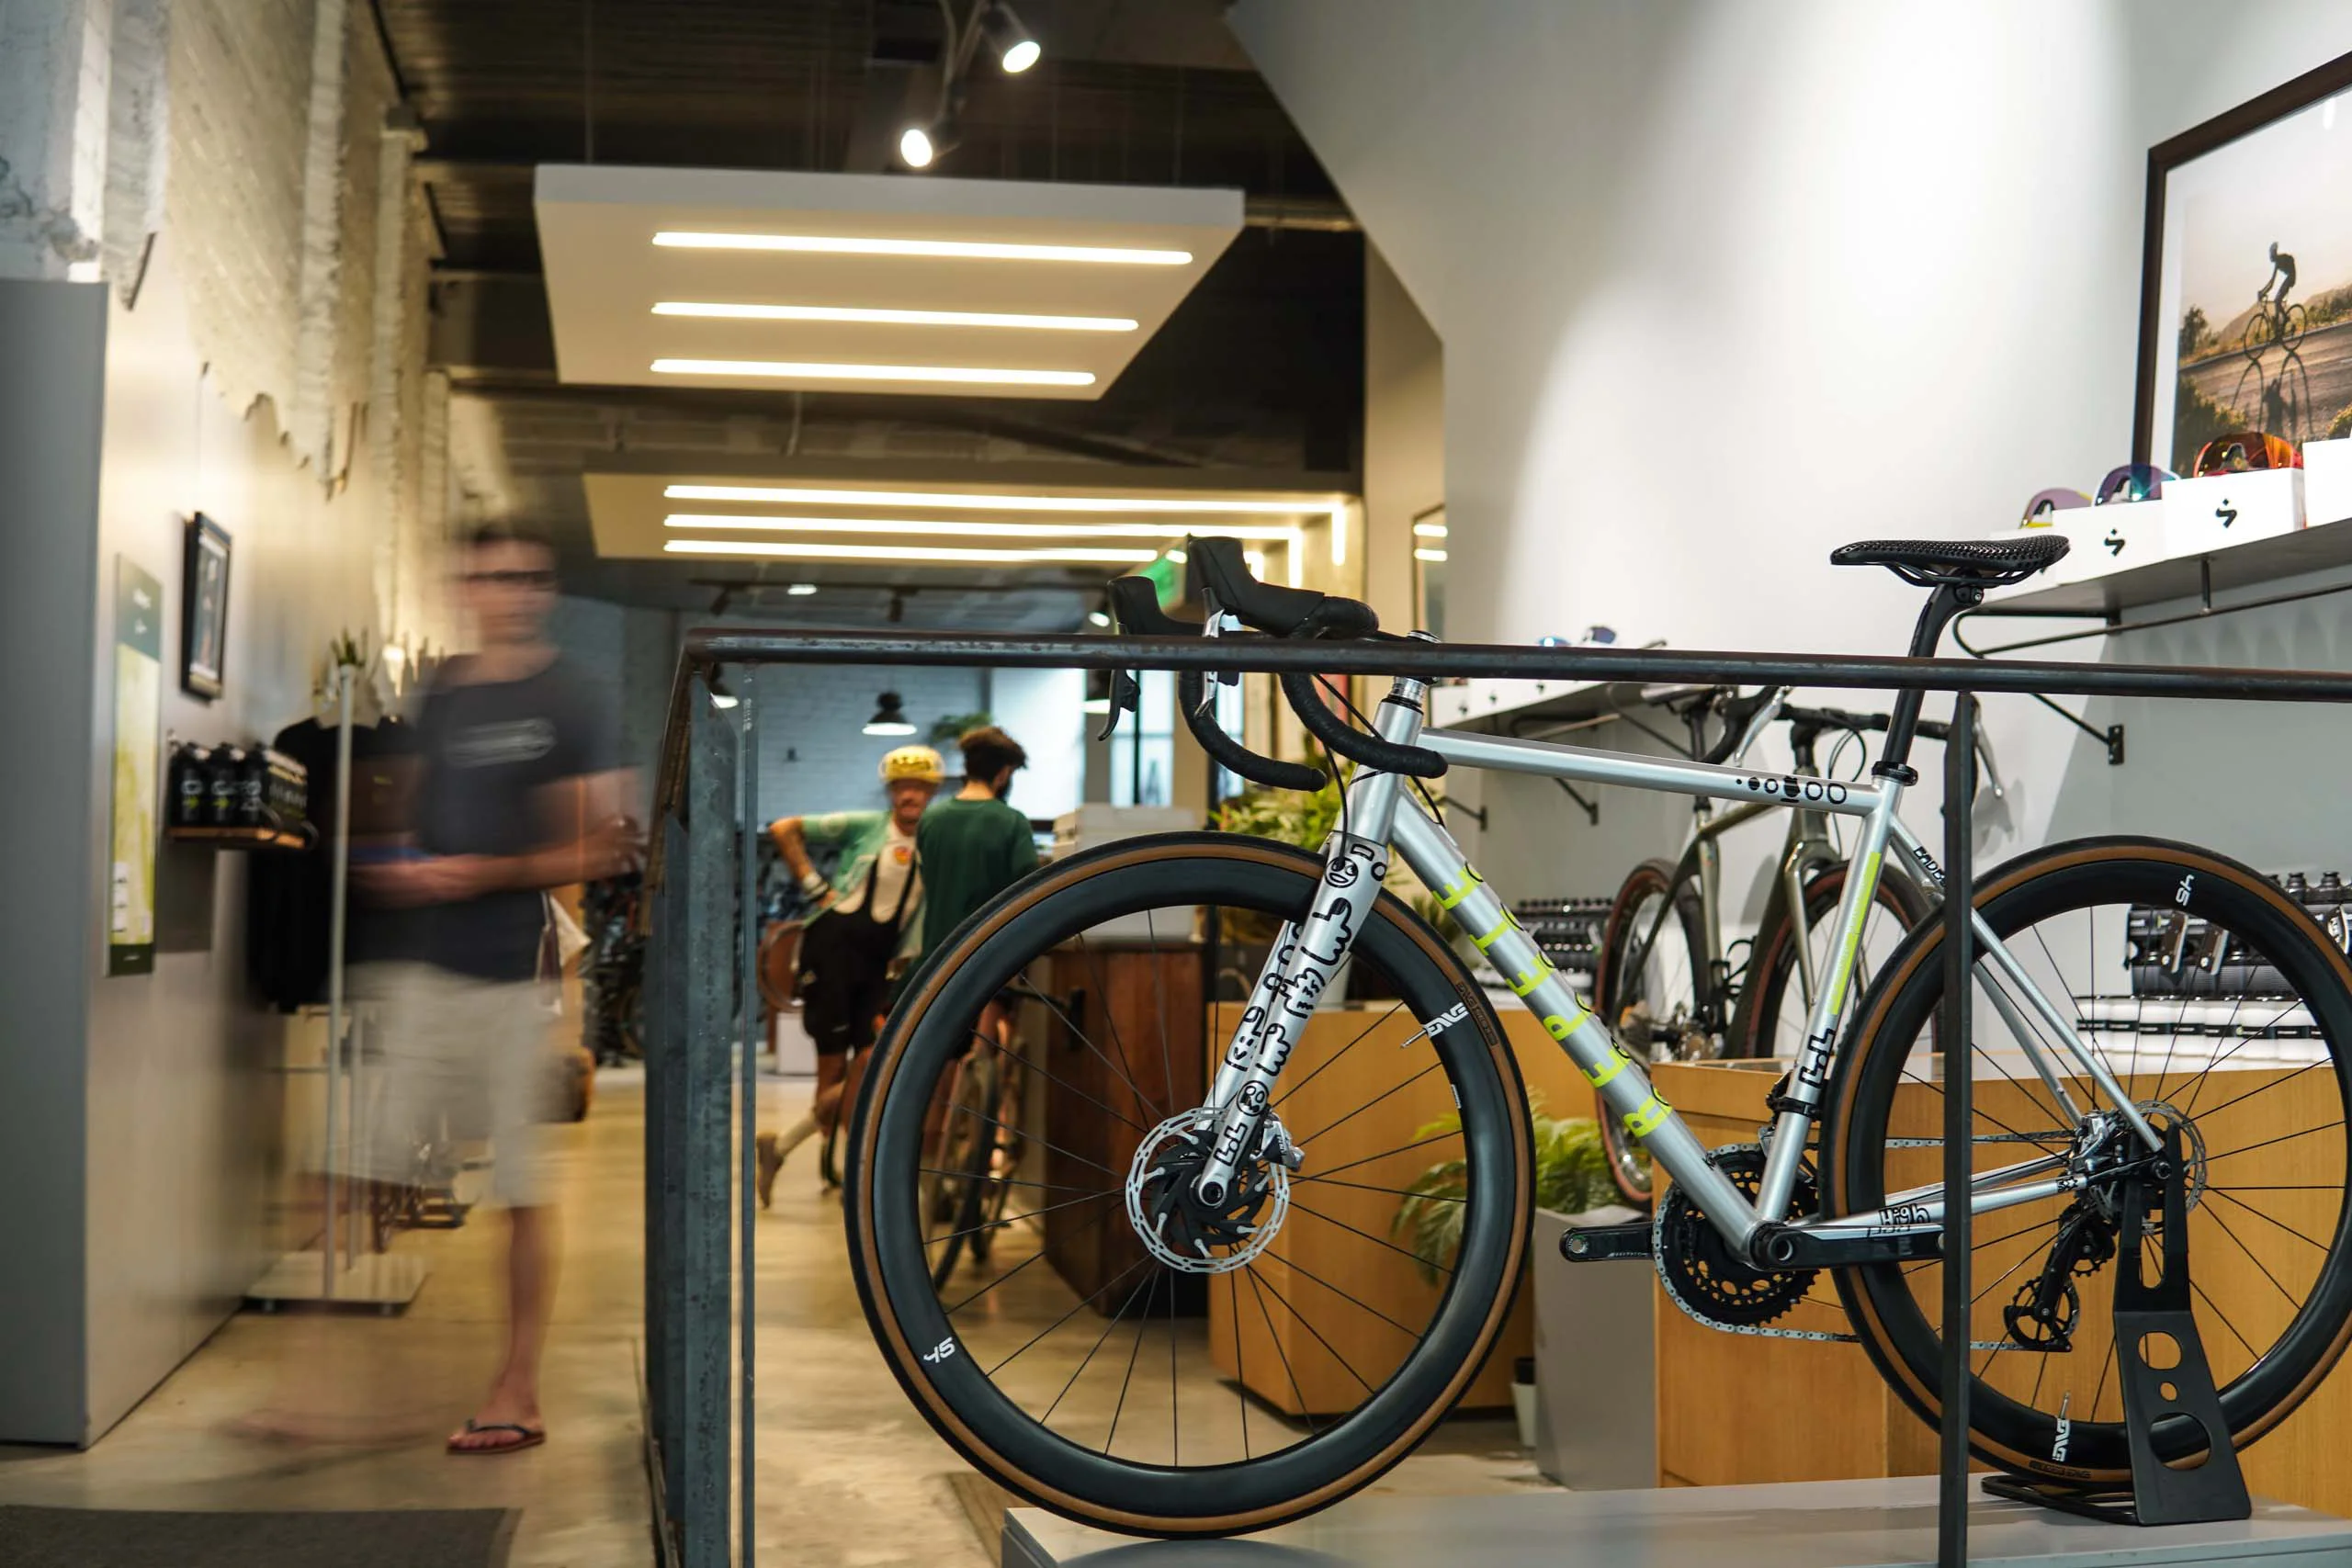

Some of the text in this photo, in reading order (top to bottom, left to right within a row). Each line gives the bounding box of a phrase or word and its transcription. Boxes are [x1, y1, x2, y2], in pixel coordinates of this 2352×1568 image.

[2176, 874, 2194, 906] 45
[1423, 1001, 1469, 1037] ENVE
[923, 1337, 956, 1363] 45
[2052, 1417, 2071, 1461] ENVE
